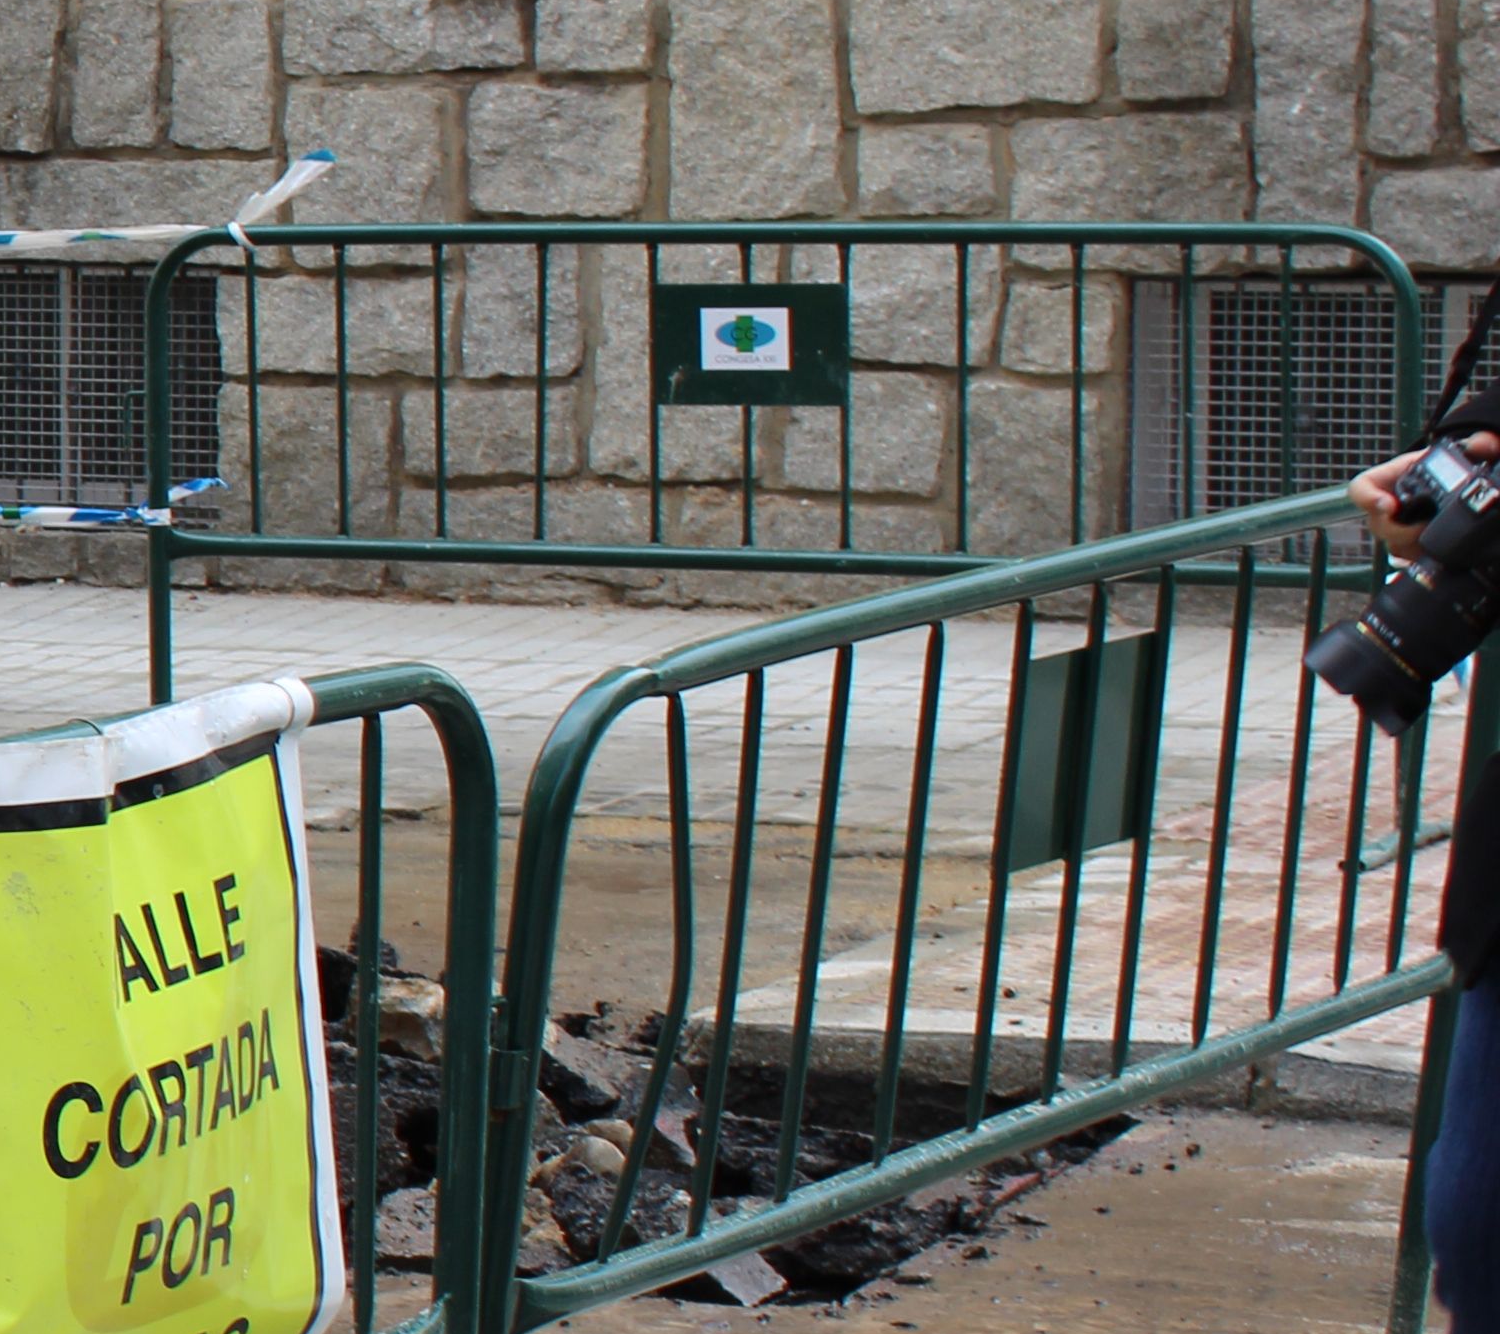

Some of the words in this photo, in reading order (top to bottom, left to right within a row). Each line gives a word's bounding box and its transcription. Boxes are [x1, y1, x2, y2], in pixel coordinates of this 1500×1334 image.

[113, 873, 246, 1007] ALLE
[42, 1008, 281, 1180] CORTADA
[120, 1187, 235, 1306] POR
